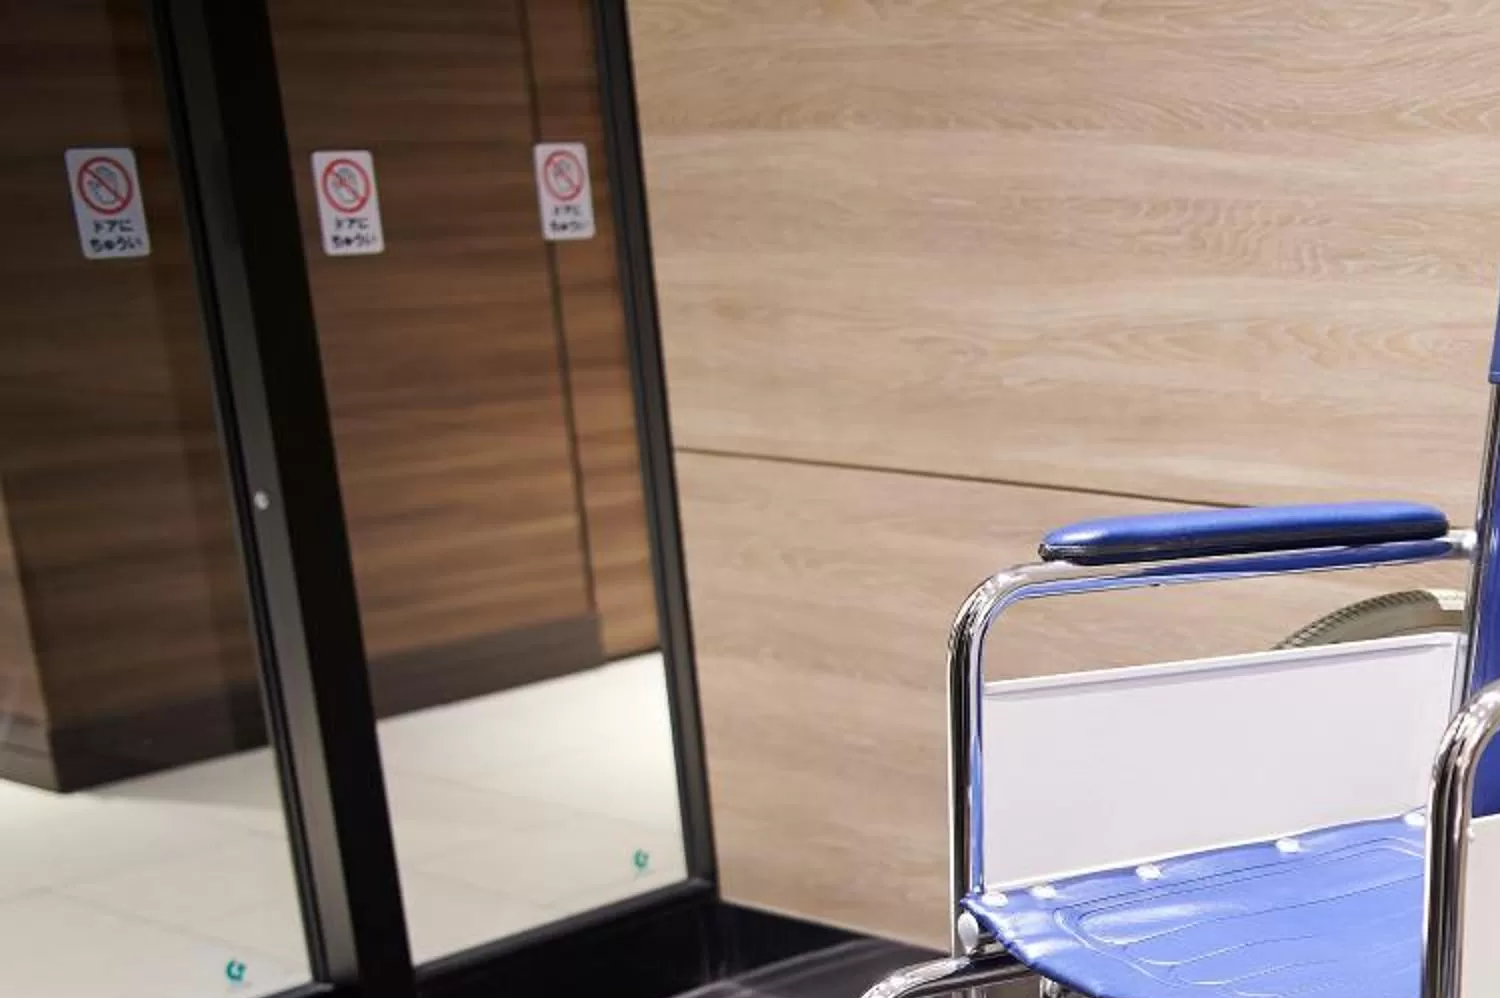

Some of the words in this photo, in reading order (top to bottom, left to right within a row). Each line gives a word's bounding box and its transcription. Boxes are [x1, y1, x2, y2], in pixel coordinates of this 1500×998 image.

[93, 220, 134, 233] ドアに
[90, 237, 143, 253] ちゅうい
